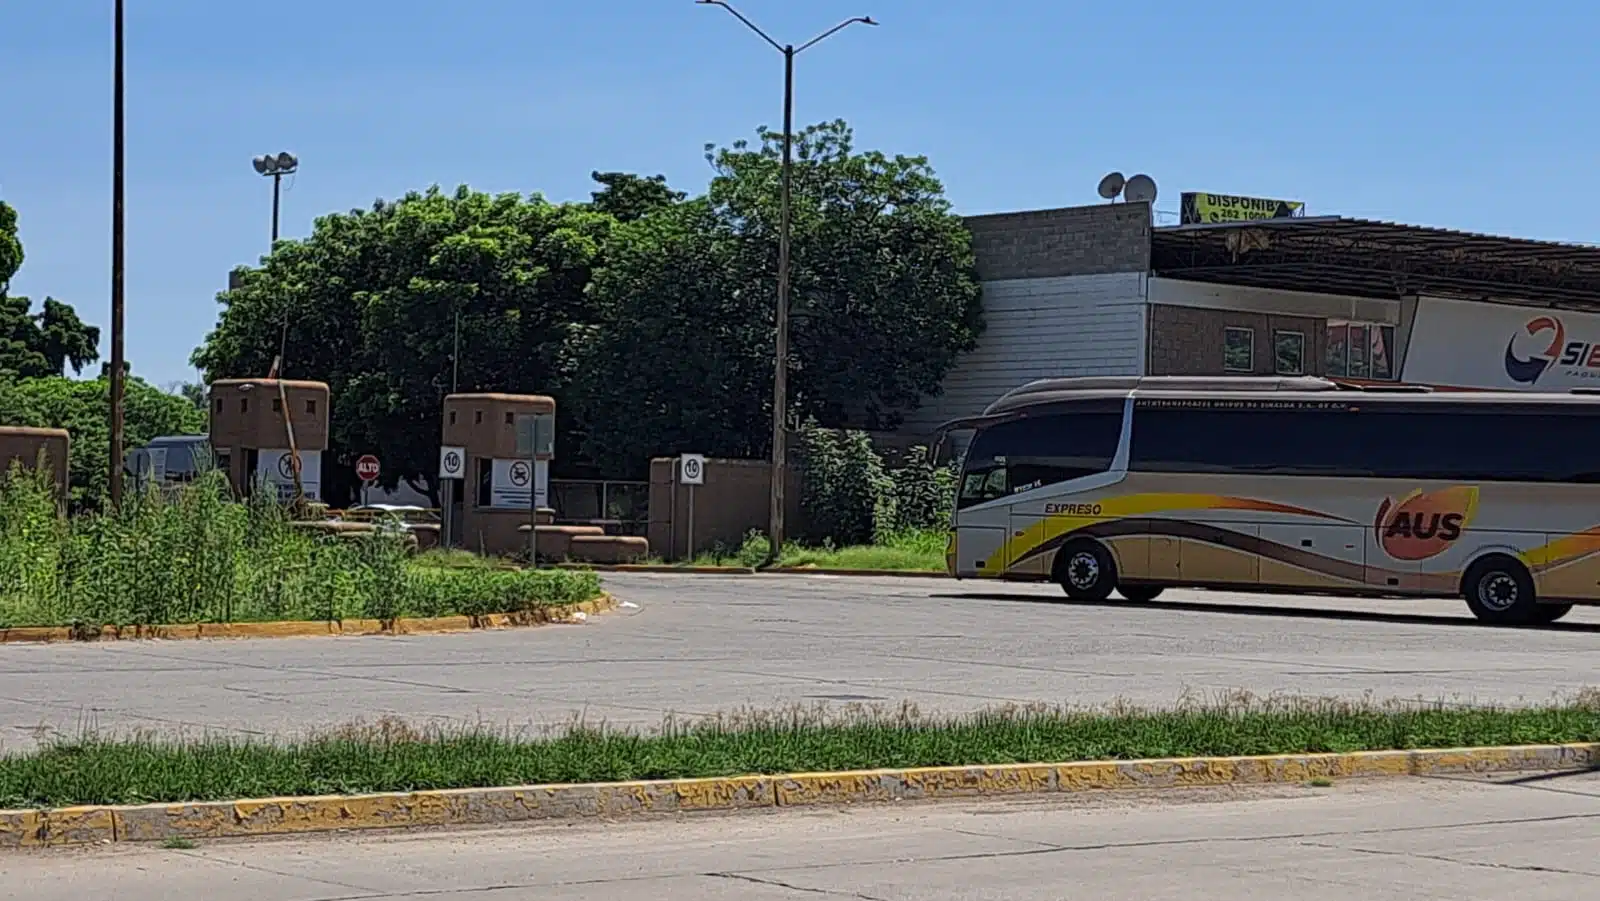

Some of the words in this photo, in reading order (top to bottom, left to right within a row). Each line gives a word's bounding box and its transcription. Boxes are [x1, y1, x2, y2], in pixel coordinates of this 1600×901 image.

[447, 454, 457, 466] 10
[358, 463, 379, 473] ALTO
[688, 461, 697, 473] 10
[1045, 503, 1102, 515] EXPRESO
[1384, 511, 1464, 541] AUS
